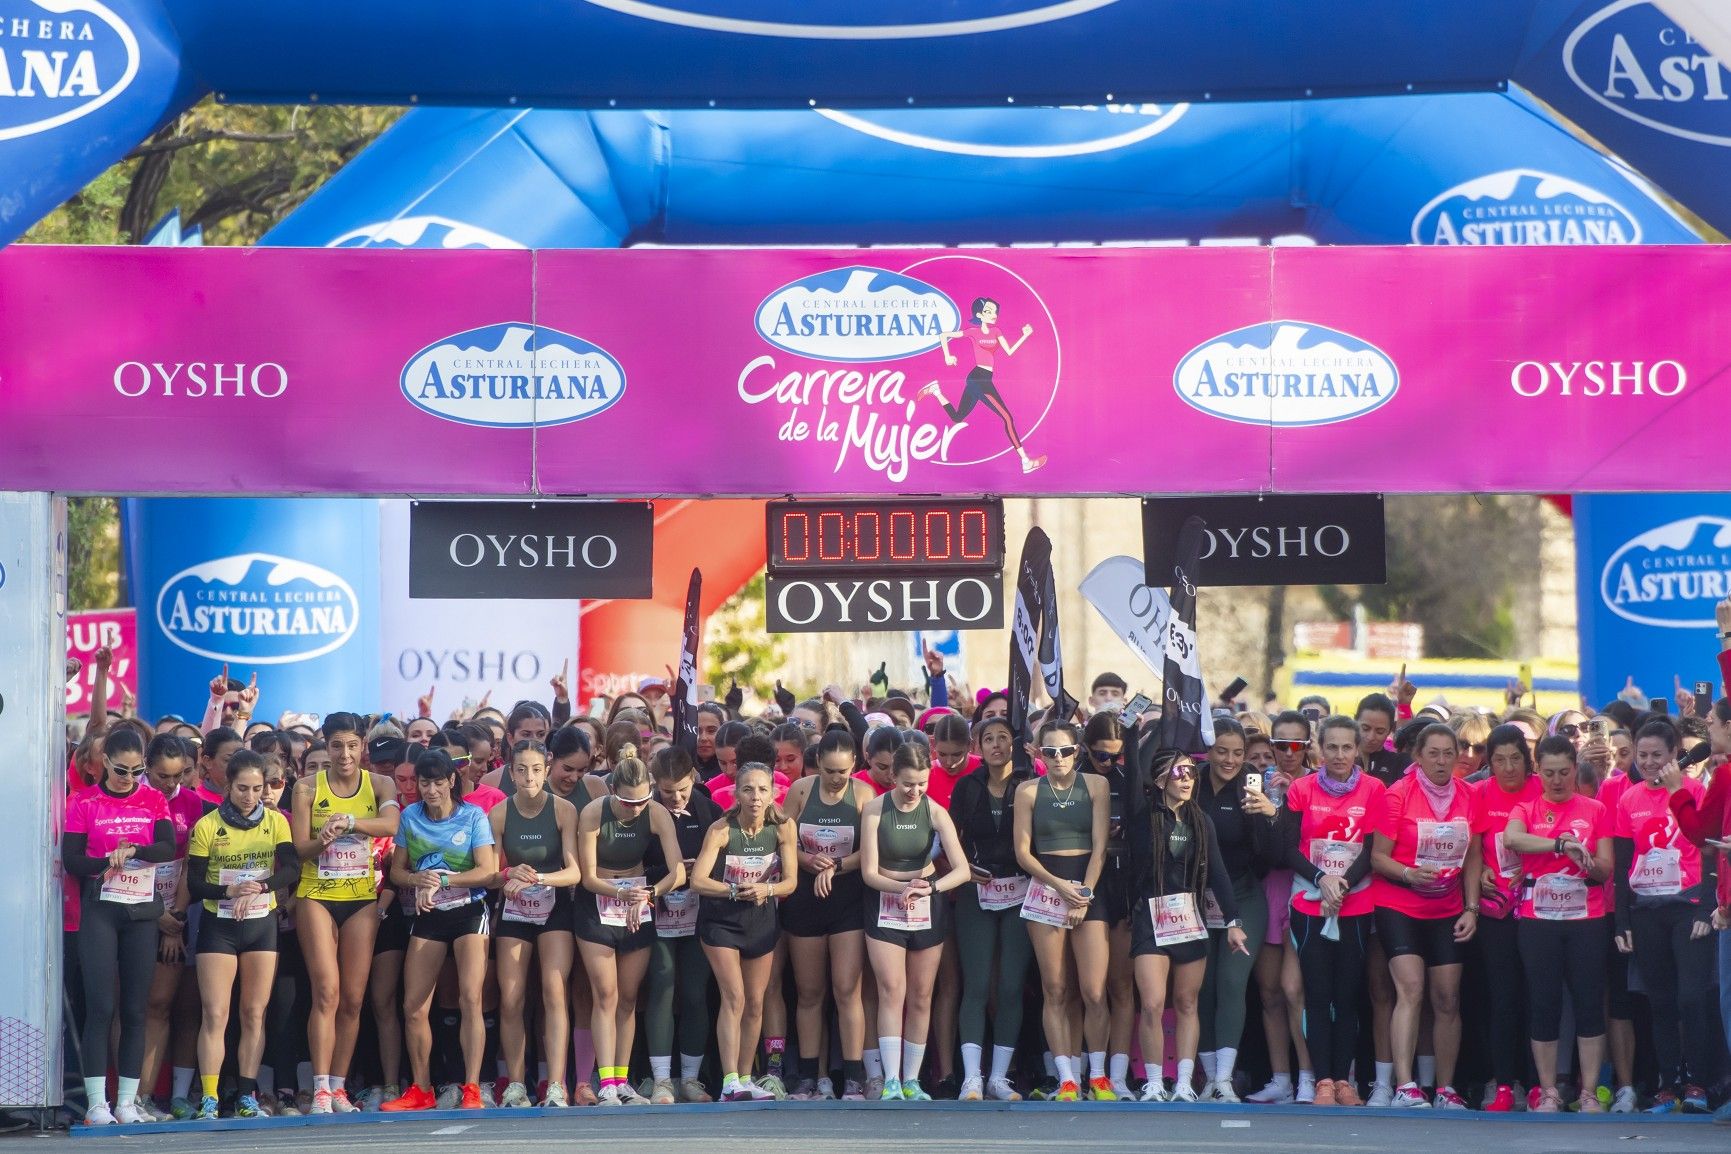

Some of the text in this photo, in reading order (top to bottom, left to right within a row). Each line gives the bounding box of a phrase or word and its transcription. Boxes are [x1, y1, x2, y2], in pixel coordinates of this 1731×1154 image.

[1463, 204, 1537, 218] CENTRAL
[1433, 211, 1627, 244] ASTURIANA
[802, 299, 938, 309] CENTRAL LECHERA
[770, 301, 944, 337] ASTURIANA
[453, 359, 601, 369] CENTRAL LECHERA
[1226, 357, 1375, 368] CENTRAL LECHERA
[113, 361, 288, 397] OYSHO
[417, 360, 608, 400] ASTURIANA
[737, 355, 905, 405] Carrera
[1191, 359, 1381, 398] ASTURIANA
[1510, 360, 1688, 397] OYSHO
[778, 400, 969, 483] de la Mujer
[449, 533, 618, 569] OYSHO
[1642, 553, 1715, 569] CENTRAL
[197, 589, 267, 603] CENTRAL
[777, 577, 993, 625] OYSHO
[168, 589, 348, 635] ASTURIANA
[398, 648, 541, 683] OYSHO
[817, 845, 836, 853] 016
[1435, 842, 1454, 851] 016
[336, 851, 357, 860] 016
[1325, 859, 1345, 869] 016
[1644, 866, 1664, 876] 016
[121, 874, 139, 885] 016
[742, 870, 762, 879] 016
[995, 882, 1015, 893] 016
[520, 899, 540, 908] 016
[1041, 895, 1061, 907] 016
[1551, 892, 1572, 901] 016
